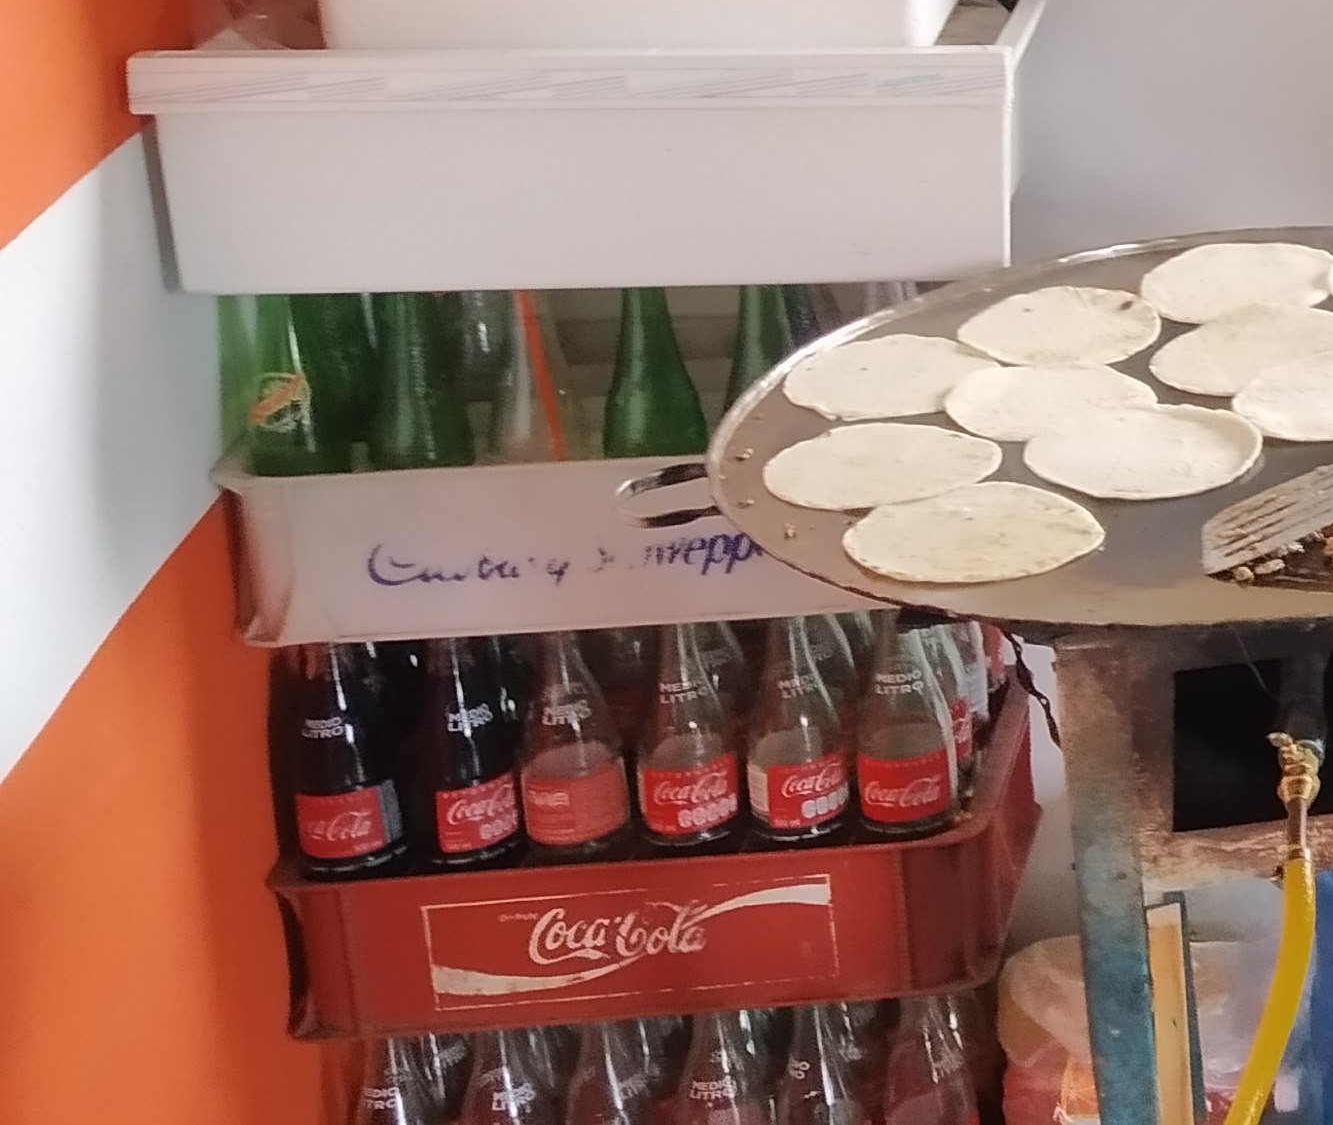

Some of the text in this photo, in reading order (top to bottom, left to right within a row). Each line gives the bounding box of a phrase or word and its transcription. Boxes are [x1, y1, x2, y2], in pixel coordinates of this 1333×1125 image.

[876, 670, 921, 684] MEDIO
[875, 680, 924, 695] LITRO
[529, 900, 706, 965] Coca-Cola
